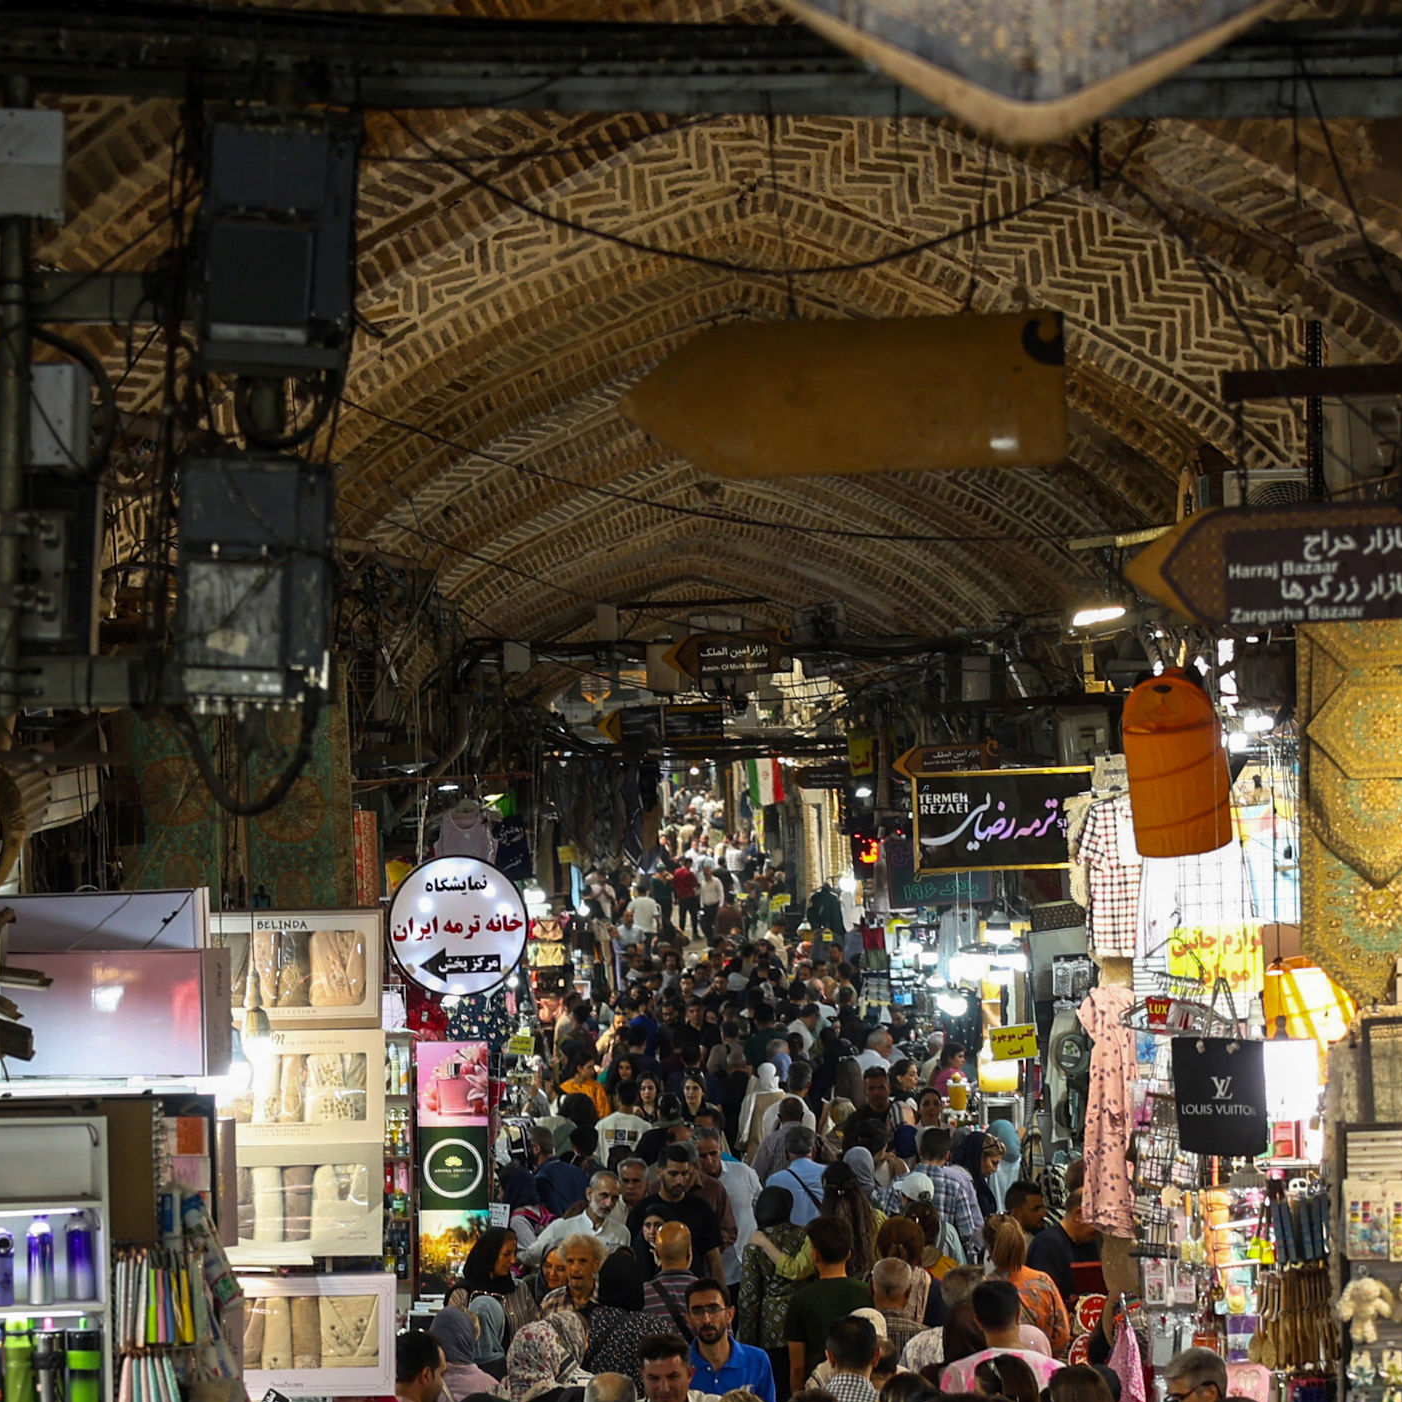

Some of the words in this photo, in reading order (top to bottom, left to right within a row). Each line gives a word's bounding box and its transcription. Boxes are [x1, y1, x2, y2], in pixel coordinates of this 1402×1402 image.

[1303, 529, 1357, 561] حراج
[1228, 562, 1279, 580] Harraj
[1282, 560, 1339, 577] Bazaar
[1280, 575, 1361, 605] زرگرها
[1307, 604, 1365, 620] Bazaar
[700, 646, 728, 657] الملک
[729, 645, 750, 658] امین
[751, 644, 768, 657] بازار
[746, 661, 768, 670] Bazaar
[918, 792, 969, 804] TERMEH
[920, 803, 969, 815] REZAEI
[1014, 798, 1059, 841] ترمه
[257, 920, 308, 931] BELINDA
[393, 915, 438, 941] ایران
[443, 914, 480, 939] ترمه
[486, 913, 523, 933] خانه
[1172, 929, 1217, 957] جانبی
[1222, 926, 1263, 954] لوازم
[438, 957, 468, 973] پخش
[471, 956, 499, 972] مرکز
[1149, 1004, 1168, 1015] LUX
[1181, 1104, 1213, 1116] LOUIS
